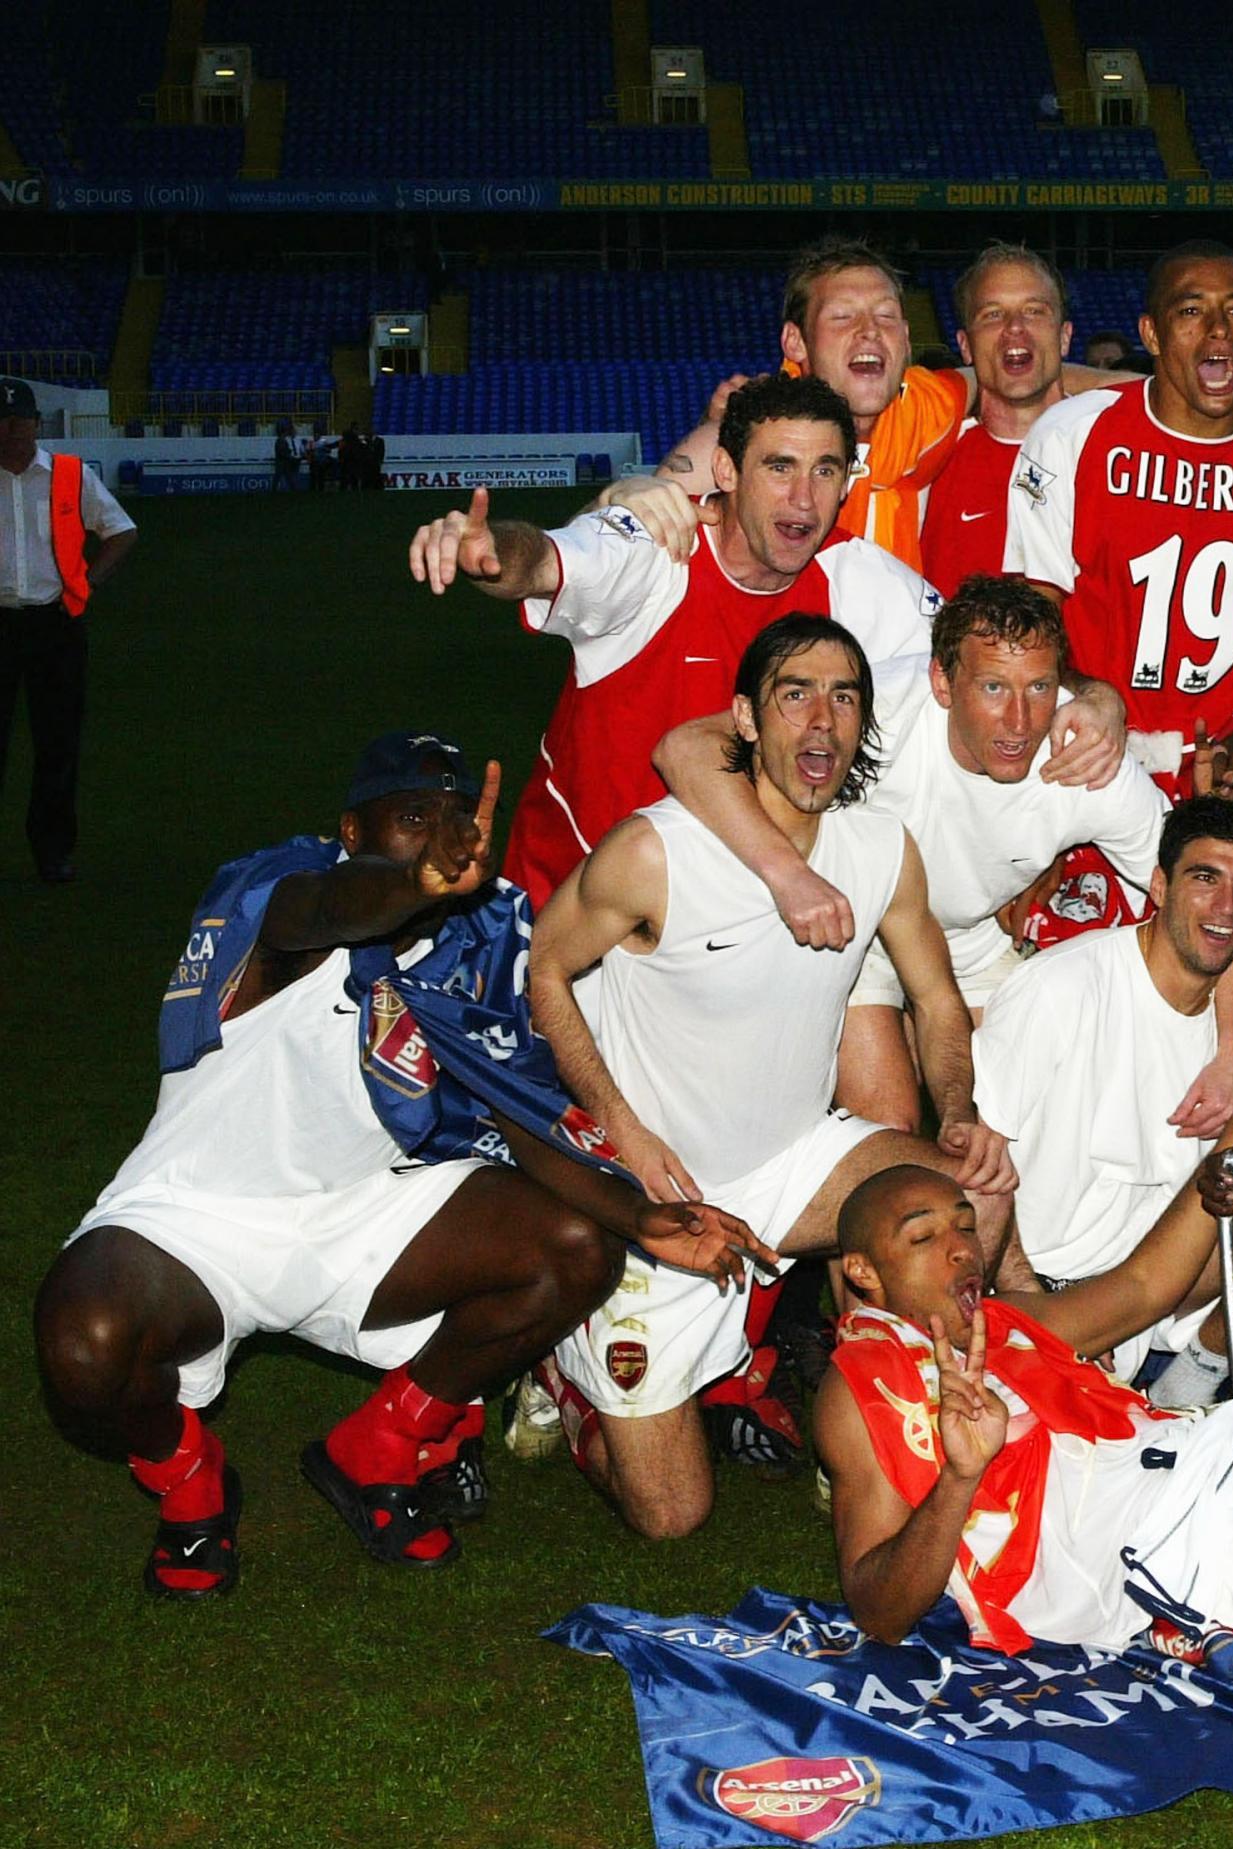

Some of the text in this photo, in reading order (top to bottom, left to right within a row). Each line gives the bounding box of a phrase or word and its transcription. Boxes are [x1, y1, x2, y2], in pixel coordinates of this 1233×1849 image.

[73, 186, 133, 206] spurs
[413, 186, 471, 206] spurs
[561, 185, 813, 206] ANDERSON CONSTRUCTION
[946, 186, 1018, 205] COUNTY
[1026, 186, 1167, 206] CARRIAGEWAYS
[464, 470, 568, 481] GENERATORS
[722, 1770, 854, 1792] Arsenal
